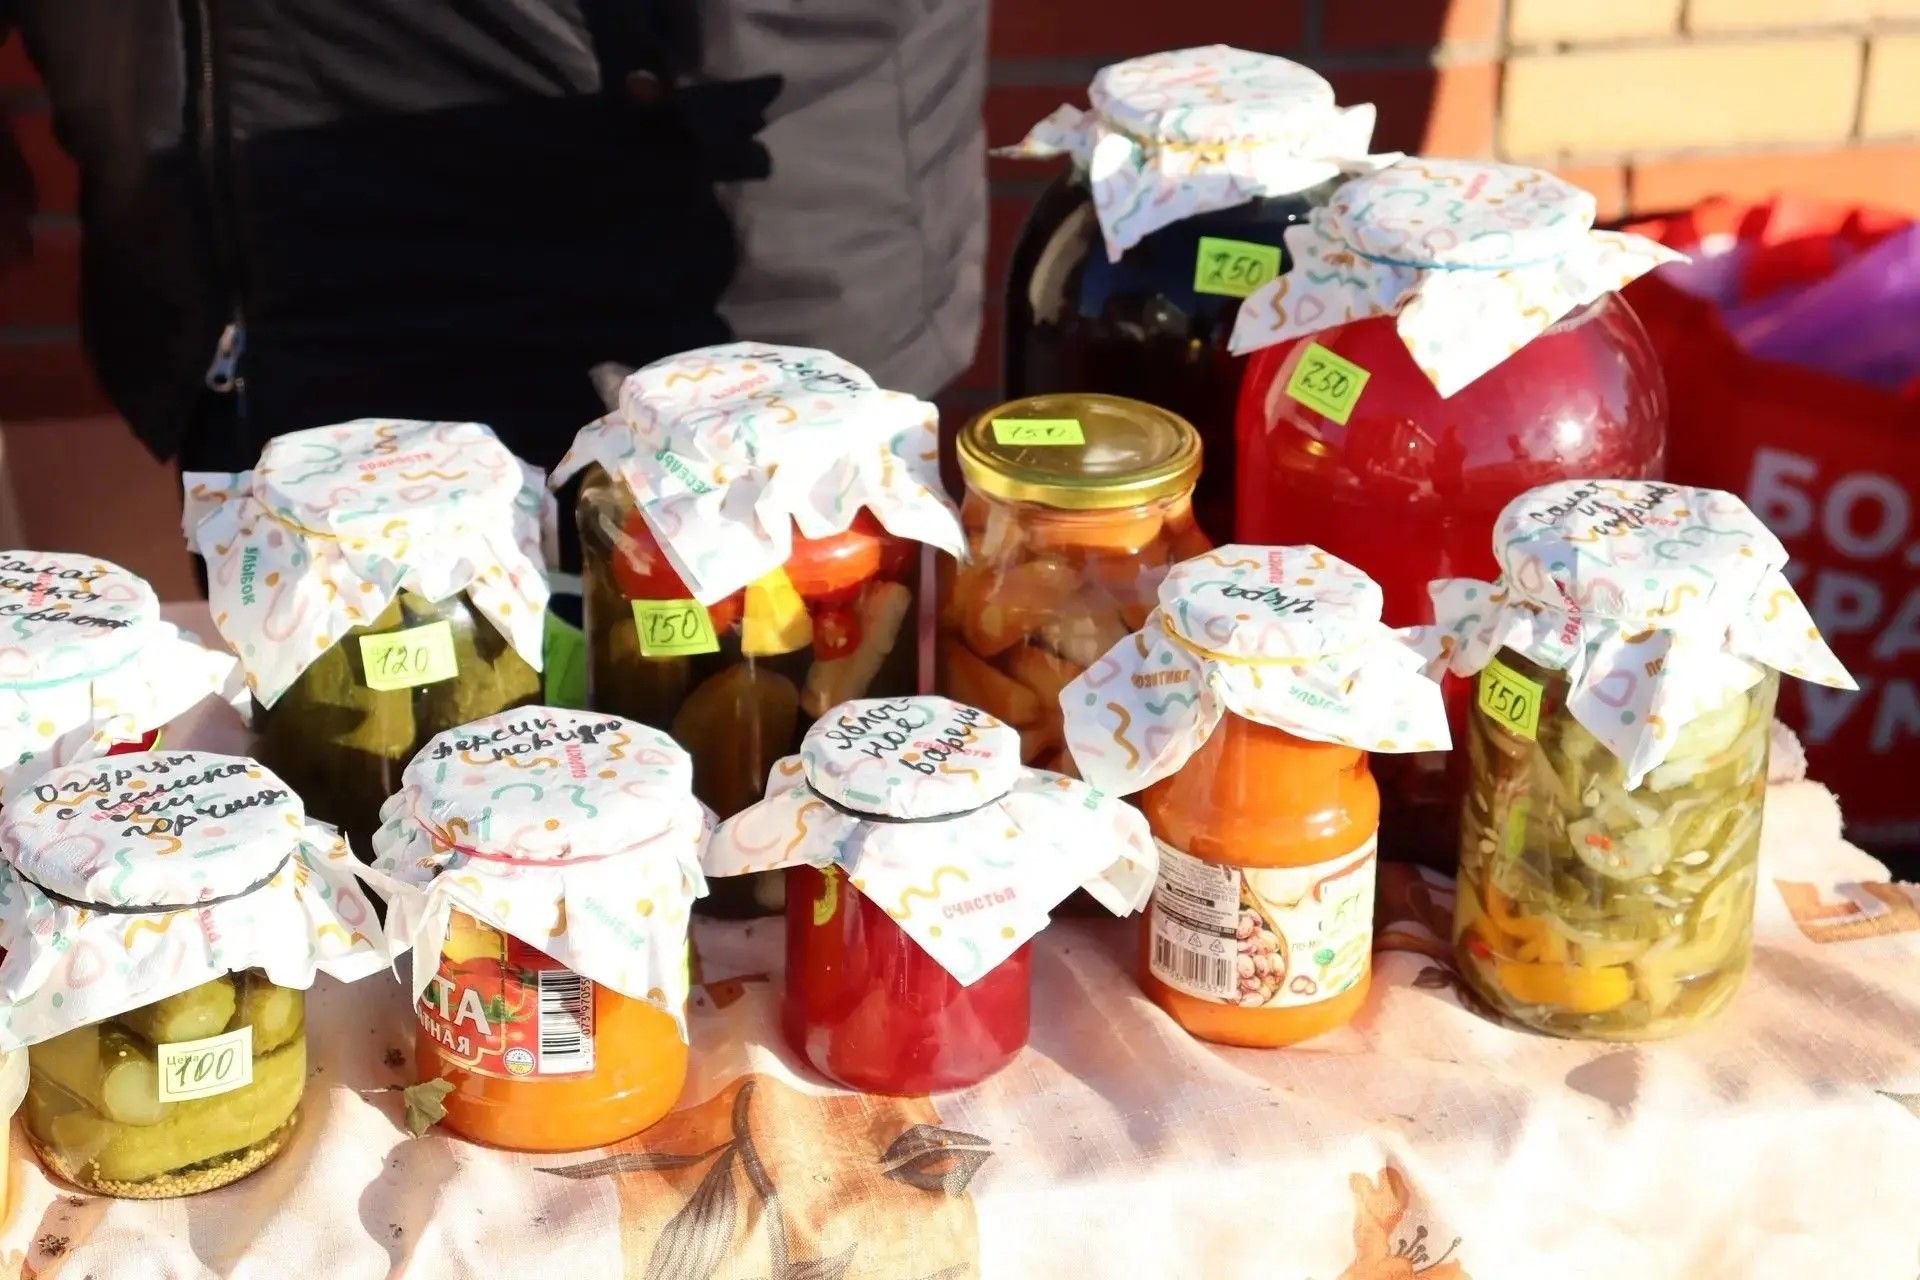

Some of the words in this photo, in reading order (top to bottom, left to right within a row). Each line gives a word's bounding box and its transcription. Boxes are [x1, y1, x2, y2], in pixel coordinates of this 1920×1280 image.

[1209, 252, 1263, 286] 250
[1301, 361, 1349, 398] 250
[649, 609, 699, 642] 150
[376, 645, 428, 675] 120
[1488, 680, 1526, 721] 150
[941, 886, 1017, 920] СЧАСТЬЯ
[175, 1047, 234, 1088] 100
